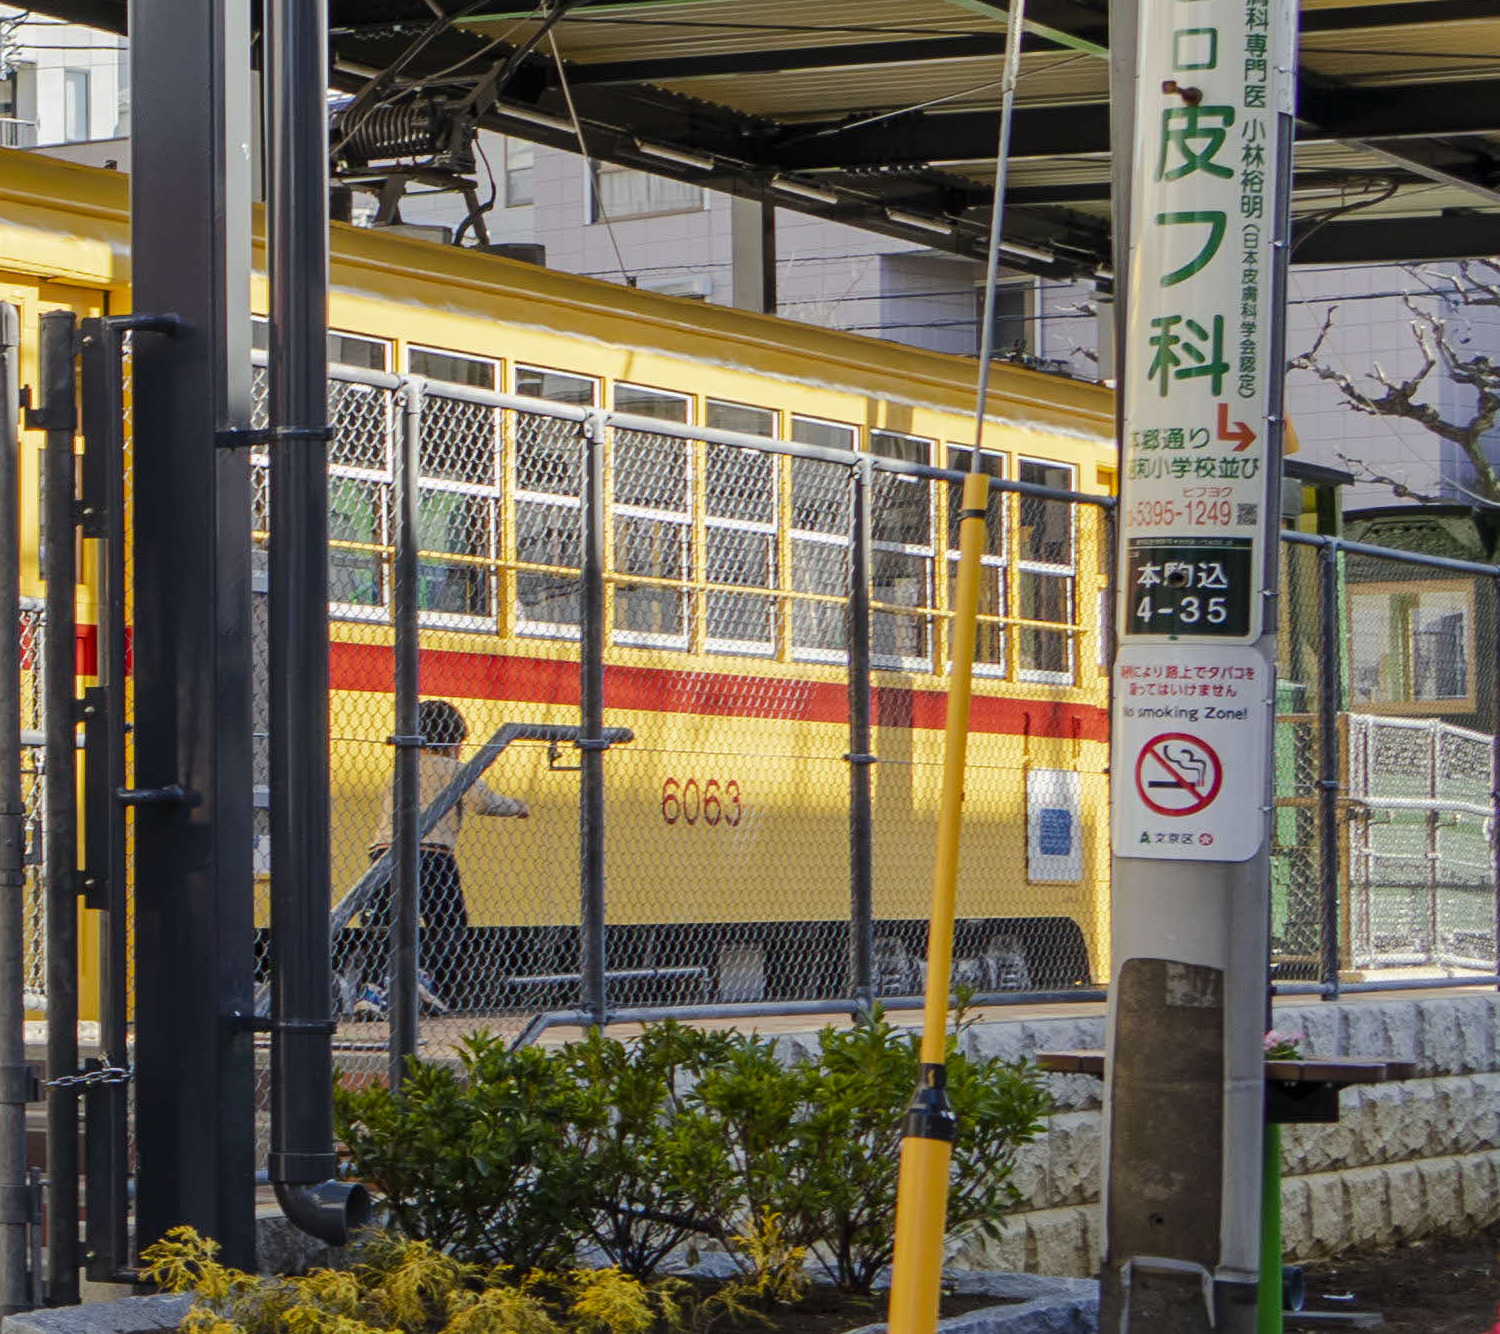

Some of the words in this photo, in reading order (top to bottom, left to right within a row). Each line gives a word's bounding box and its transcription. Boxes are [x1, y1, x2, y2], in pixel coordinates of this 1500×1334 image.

[1136, 595, 1228, 624] 4-35
[1138, 706, 1200, 723] smoking
[1203, 706, 1250, 721] Zone!
[662, 776, 742, 827] 6063
